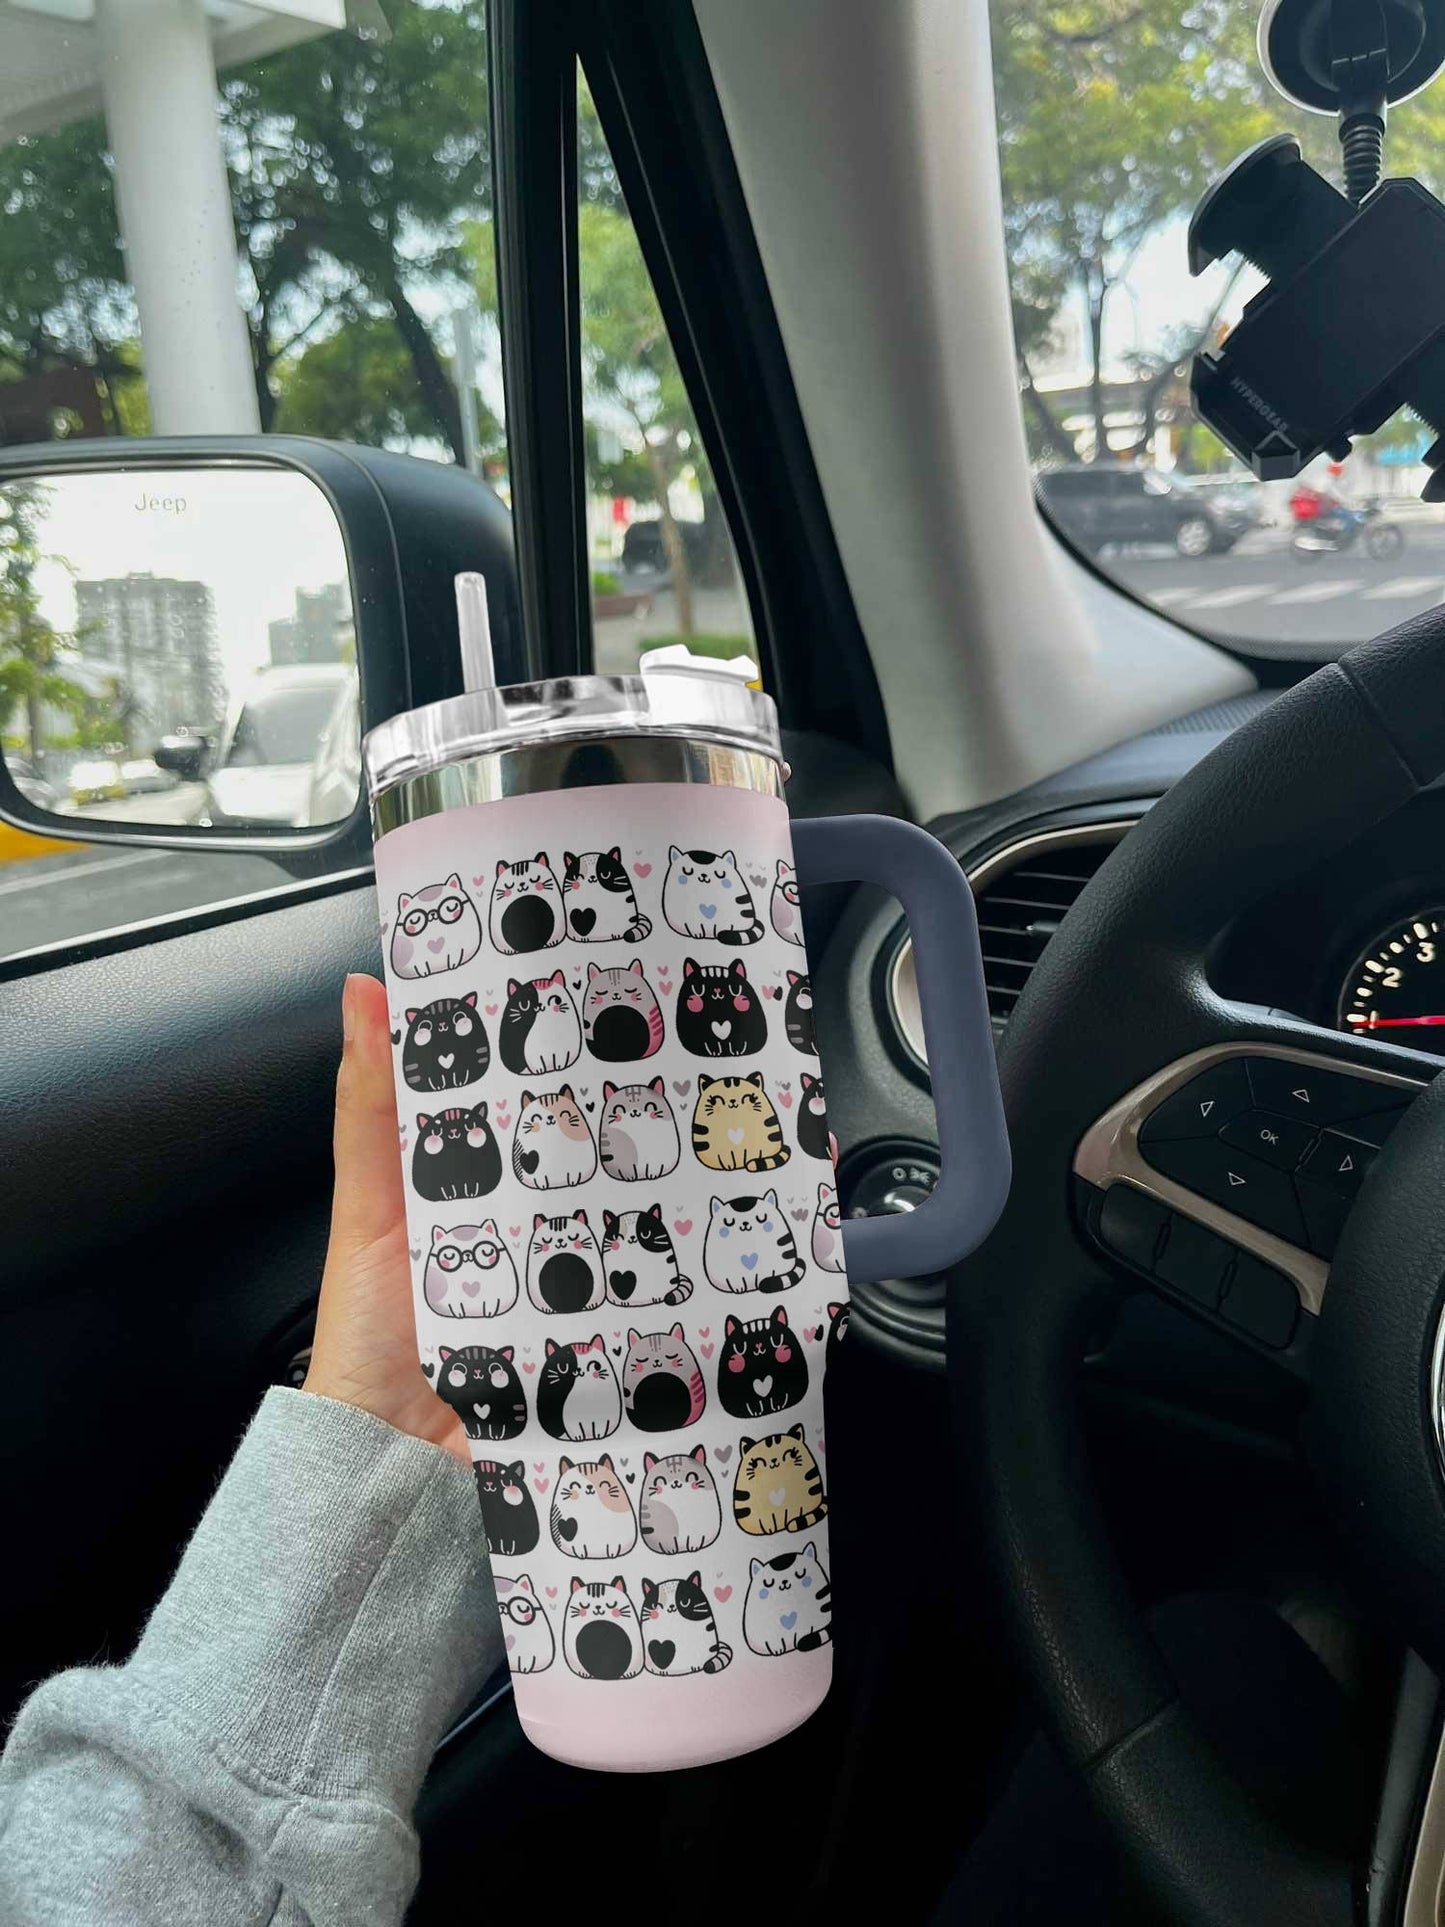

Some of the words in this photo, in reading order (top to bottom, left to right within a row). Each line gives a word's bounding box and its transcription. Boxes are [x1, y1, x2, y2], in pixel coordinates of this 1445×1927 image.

[1231, 377, 1288, 432] HYPERGEAR
[135, 493, 187, 515] Jeep
[1416, 941, 1435, 962] 3
[1382, 967, 1402, 988] 2
[1260, 1129, 1279, 1146] OK
